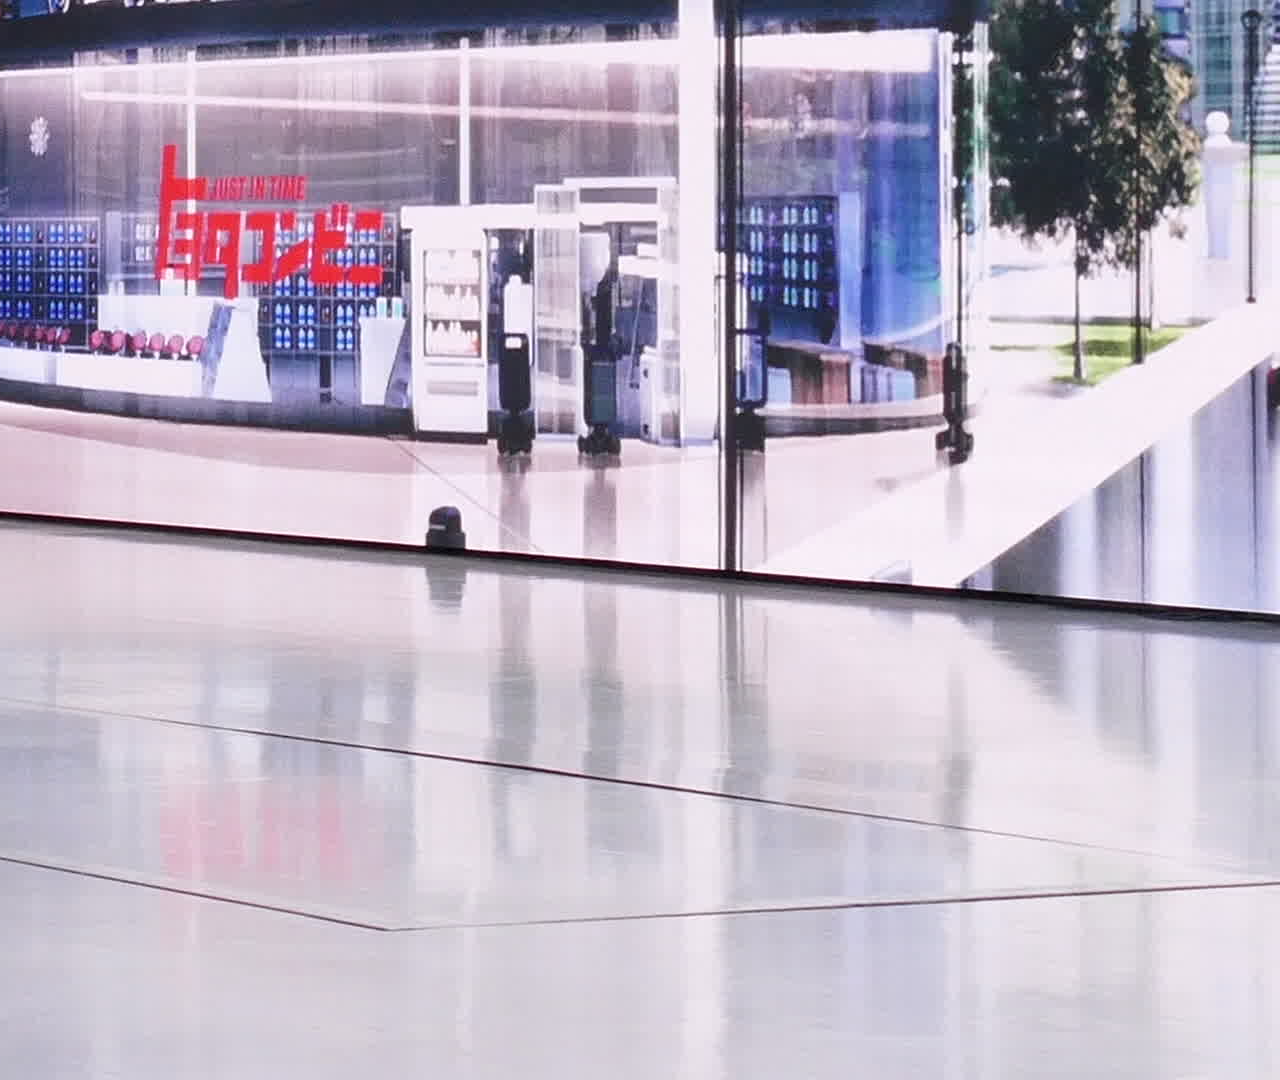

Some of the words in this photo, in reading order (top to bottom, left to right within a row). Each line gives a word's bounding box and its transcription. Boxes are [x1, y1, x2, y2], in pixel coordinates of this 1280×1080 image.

[208, 176, 247, 200] JUST
[248, 176, 266, 200] IN
[270, 176, 306, 200] TIME
